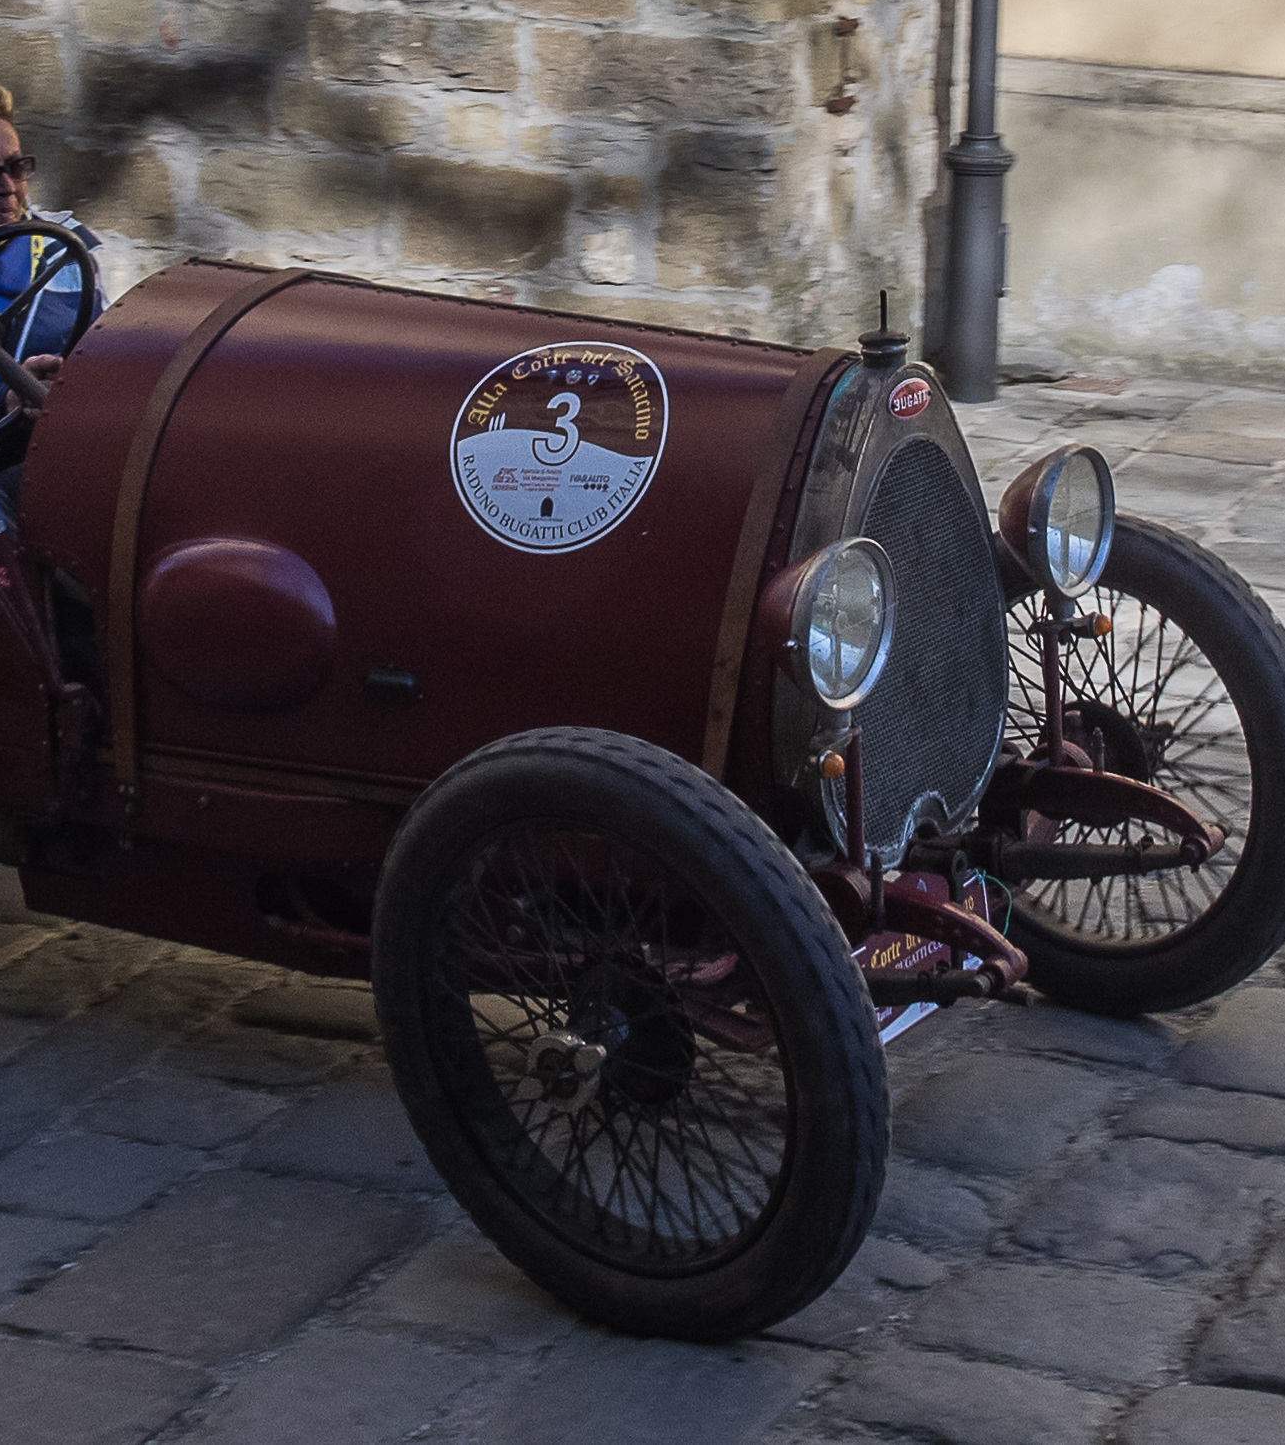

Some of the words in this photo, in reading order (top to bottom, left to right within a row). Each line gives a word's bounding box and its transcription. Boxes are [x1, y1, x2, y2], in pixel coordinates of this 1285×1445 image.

[531, 391, 582, 466] 3
[462, 453, 501, 518] RADUNO
[498, 512, 565, 541] BUGATTI
[566, 506, 609, 537] CLUB
[607, 459, 647, 511] ITALIA
[905, 933, 922, 950] de
